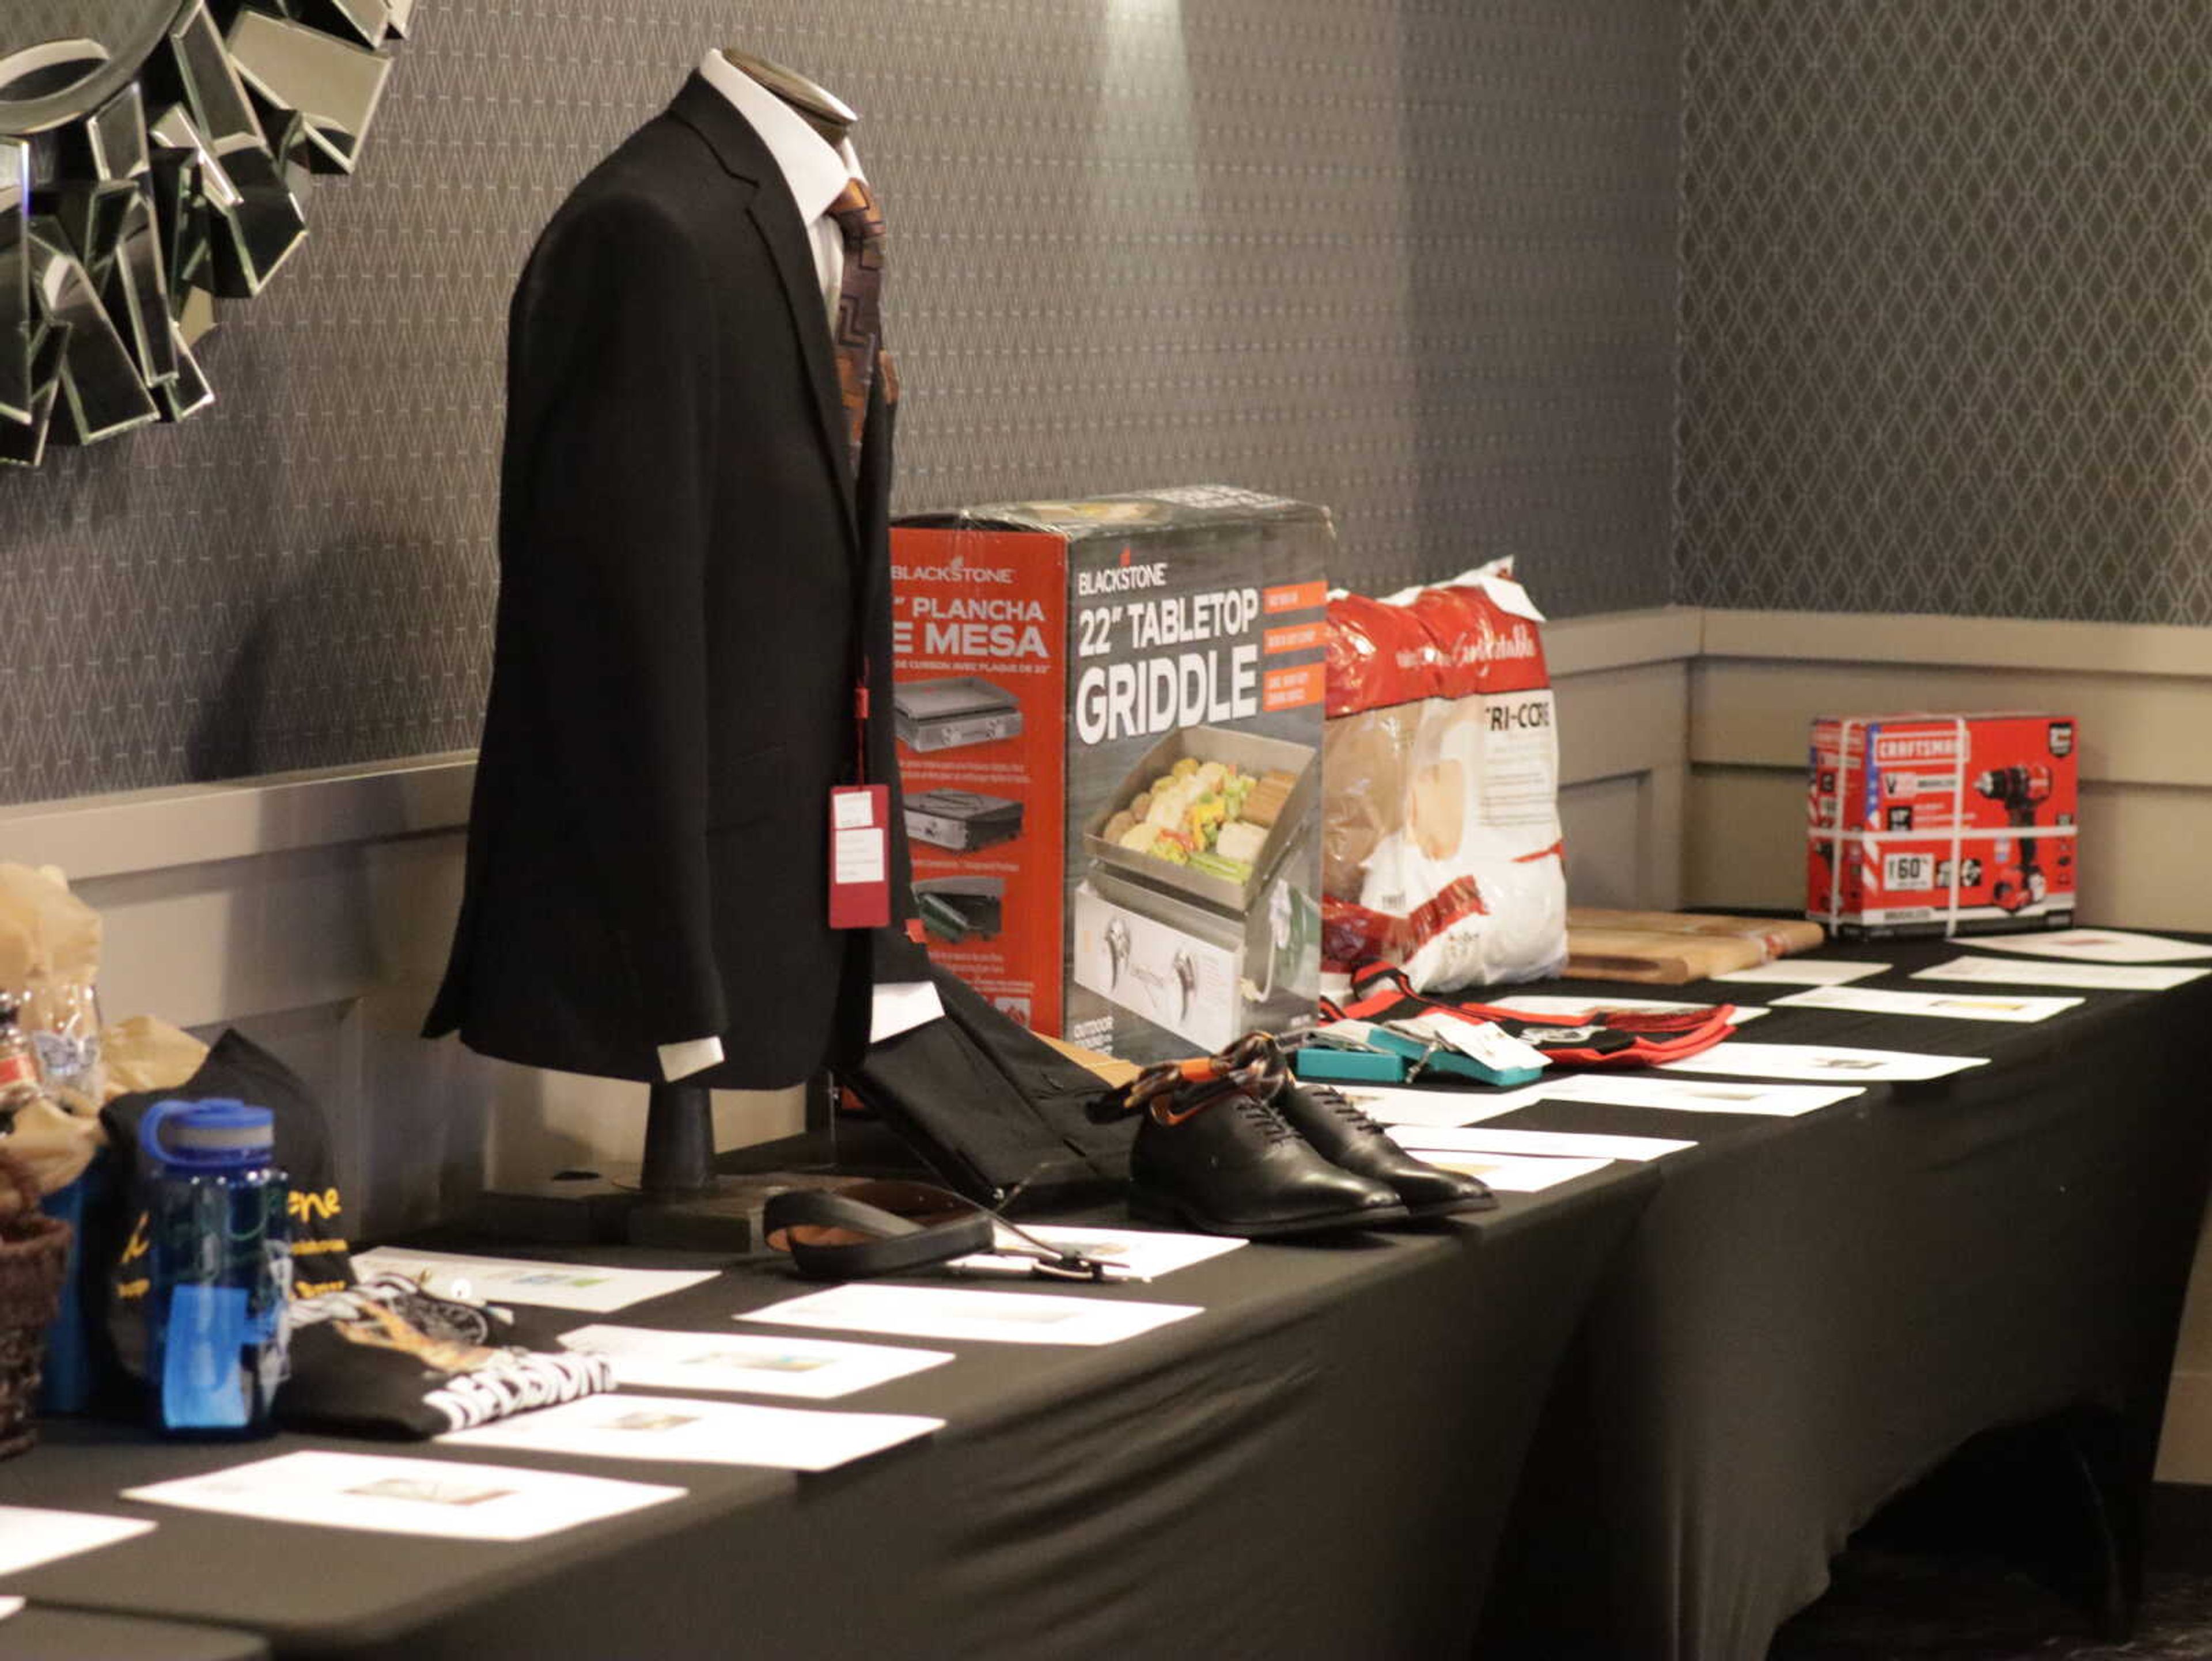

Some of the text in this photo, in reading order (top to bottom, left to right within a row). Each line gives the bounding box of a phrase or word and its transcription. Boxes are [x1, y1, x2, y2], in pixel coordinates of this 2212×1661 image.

[891, 564, 1016, 583] BLACKSTONE
[1079, 563, 1167, 596] BLACKSTONE
[912, 597, 1046, 621] PLANCHA
[1127, 587, 1259, 649] TABLETOP
[924, 621, 1049, 658] MESA
[1076, 644, 1258, 745] GRIDDLE
